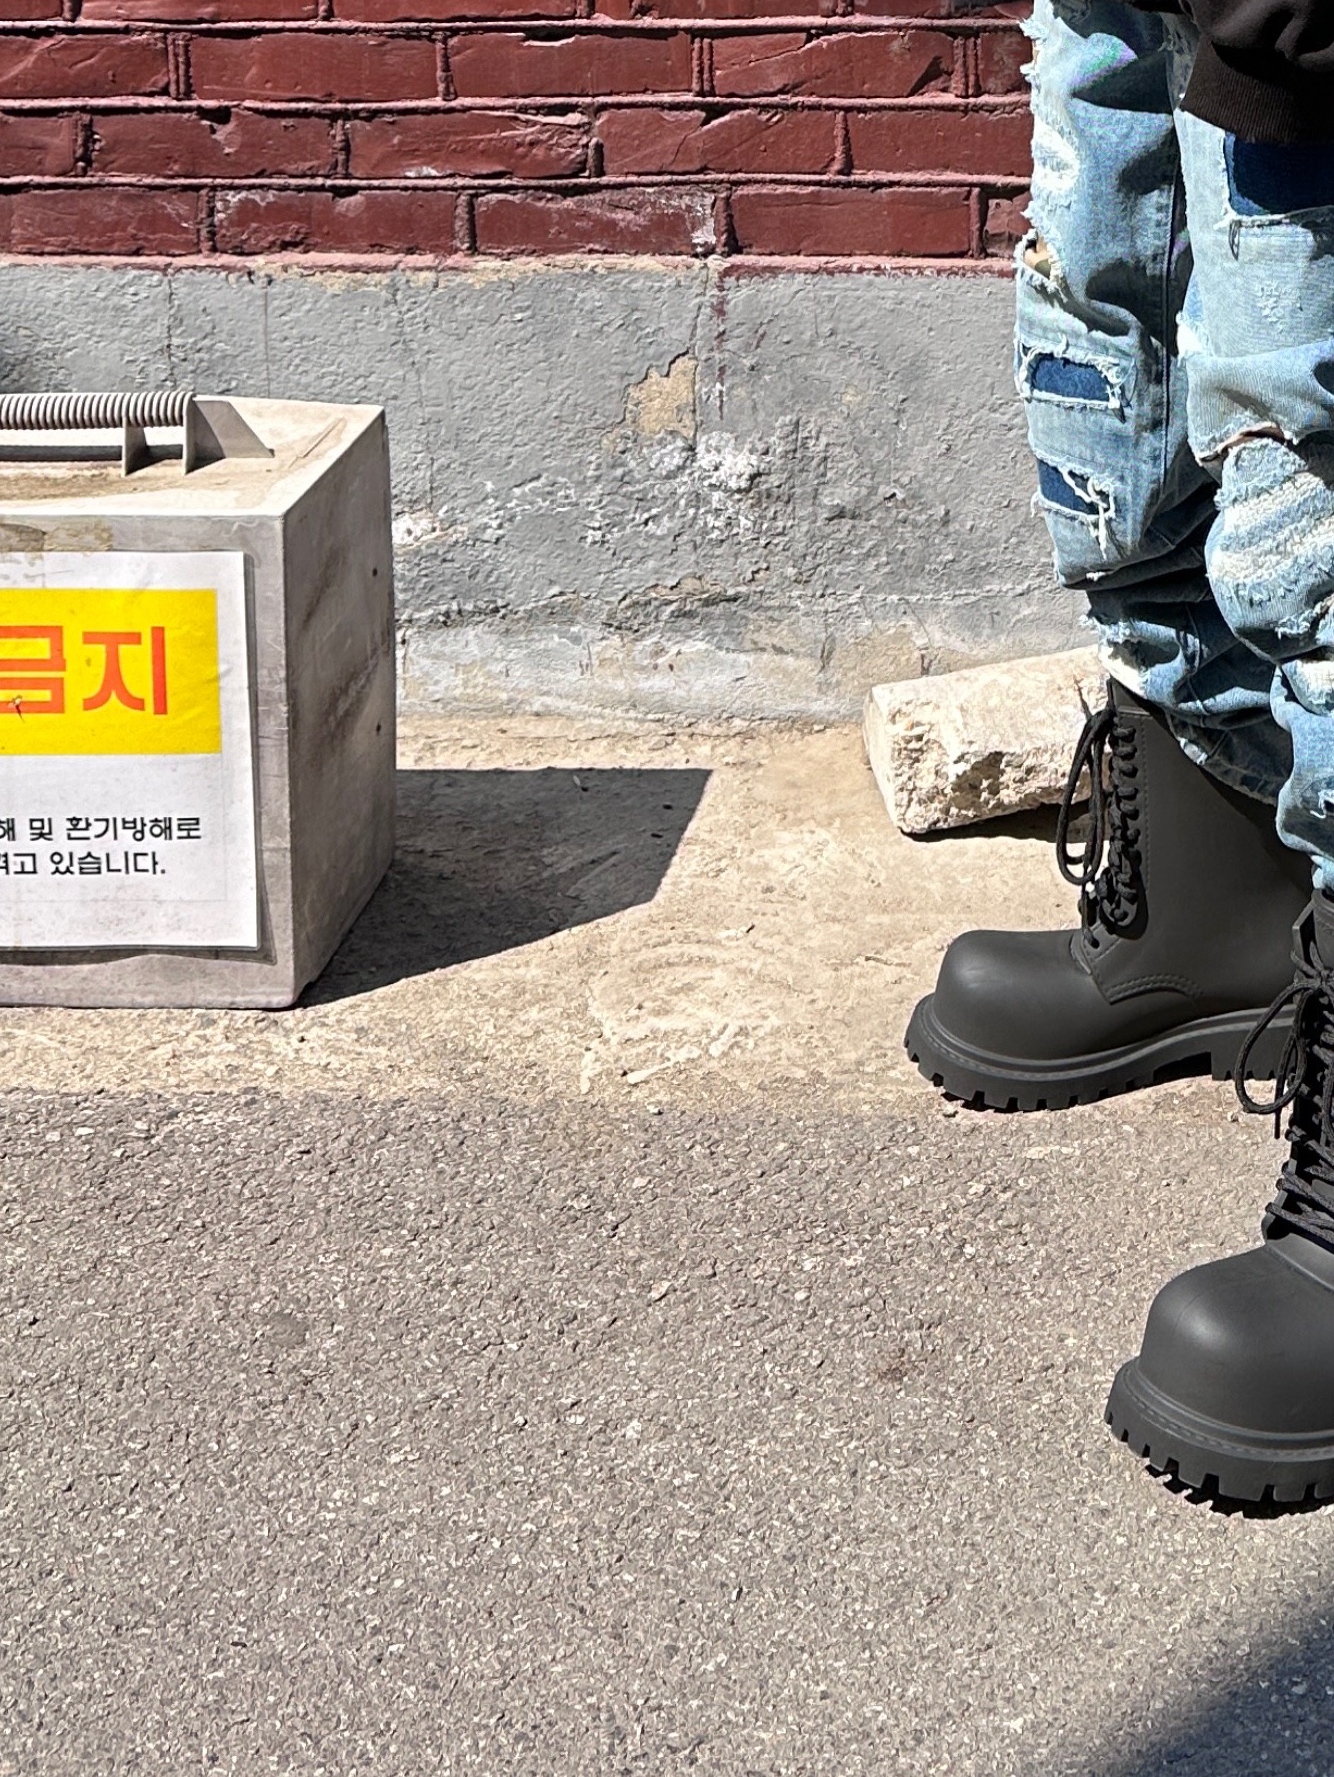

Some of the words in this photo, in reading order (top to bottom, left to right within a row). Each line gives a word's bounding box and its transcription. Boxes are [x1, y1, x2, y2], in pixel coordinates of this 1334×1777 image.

[0, 625, 168, 715] 금지
[29, 817, 53, 841] 및
[66, 816, 202, 842] 환기방해로
[50, 851, 166, 875] 있습니다.
